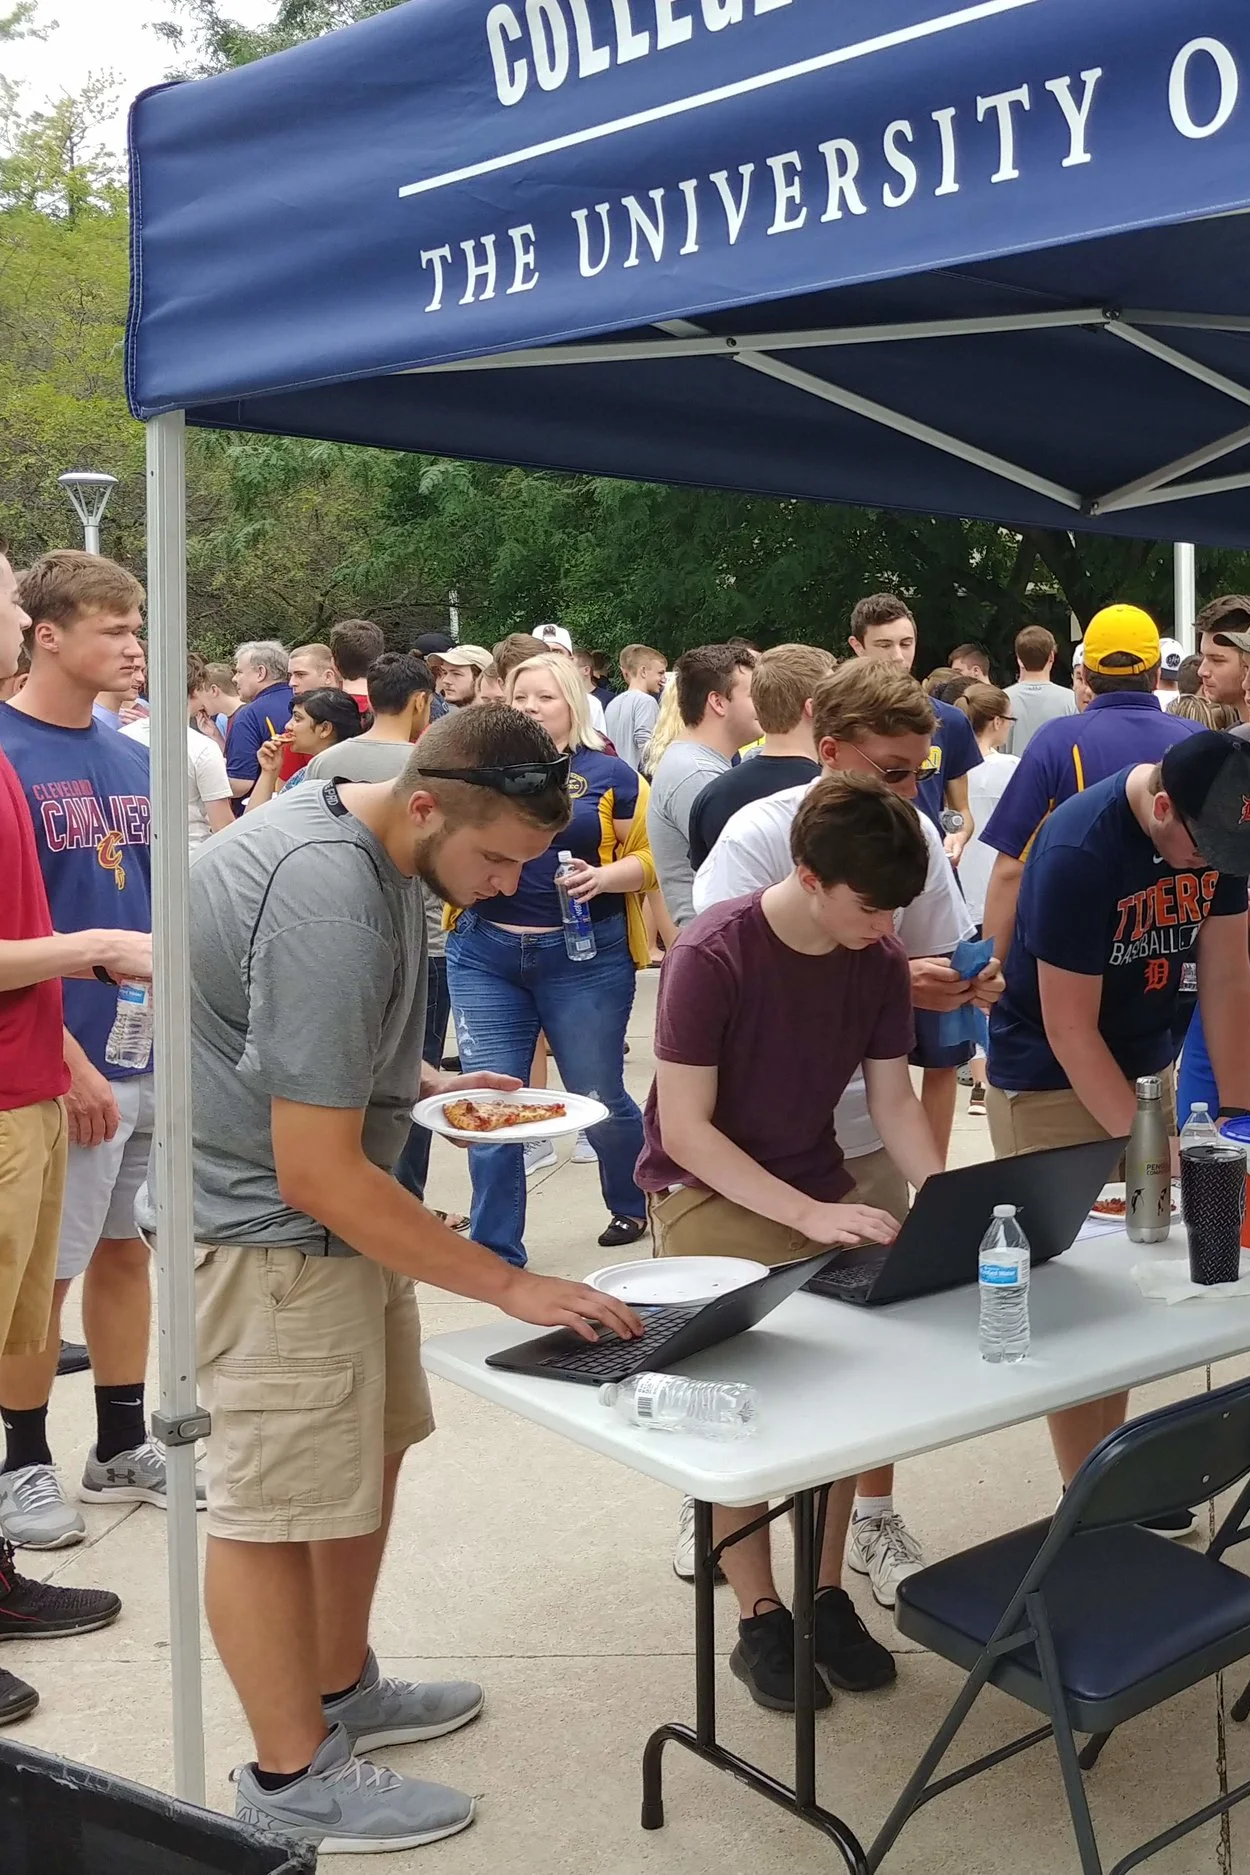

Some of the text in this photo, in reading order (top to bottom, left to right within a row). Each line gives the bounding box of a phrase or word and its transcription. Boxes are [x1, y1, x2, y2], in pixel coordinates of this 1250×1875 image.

[486, 0, 793, 106] COLLE
[420, 224, 540, 313] THE
[571, 67, 1102, 278] UNIVERSITY
